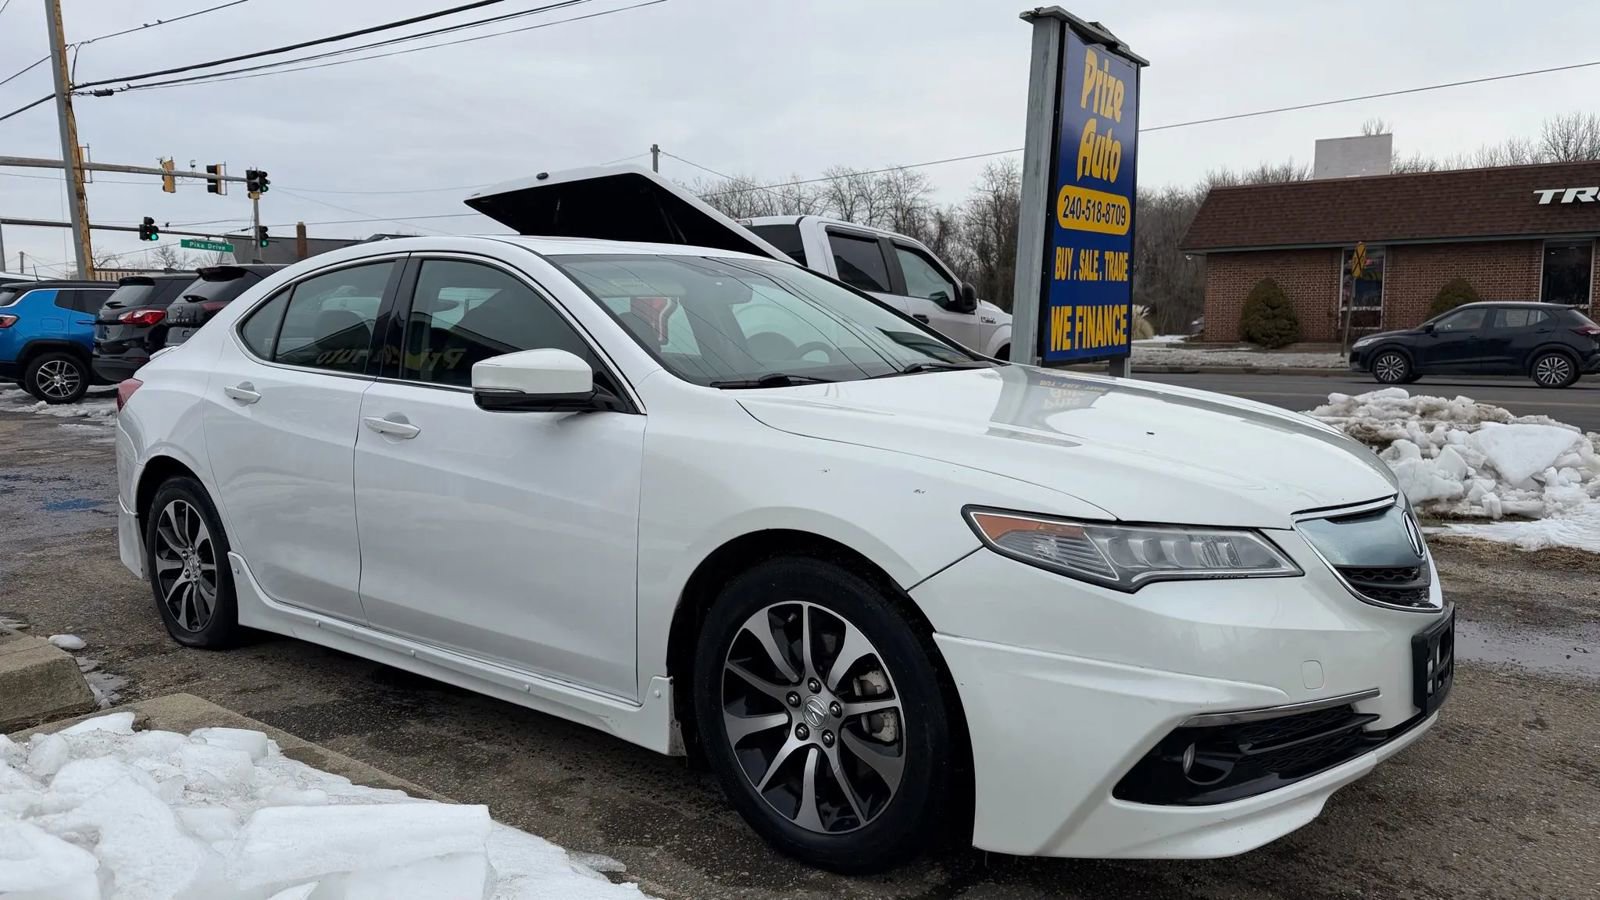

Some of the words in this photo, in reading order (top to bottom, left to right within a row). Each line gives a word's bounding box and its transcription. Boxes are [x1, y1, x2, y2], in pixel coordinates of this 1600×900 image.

[1080, 48, 1125, 123] Prize
[1076, 118, 1122, 183] Auto
[1062, 195, 1126, 226] 240-518-8709
[1533, 186, 1600, 204] TR
[207, 243, 226, 251] Drive
[1054, 247, 1074, 280] BUY
[1078, 249, 1100, 281] SALE
[1104, 251, 1129, 281] TRADE
[1050, 306, 1073, 351] WE
[1074, 304, 1128, 349] FINANCE
